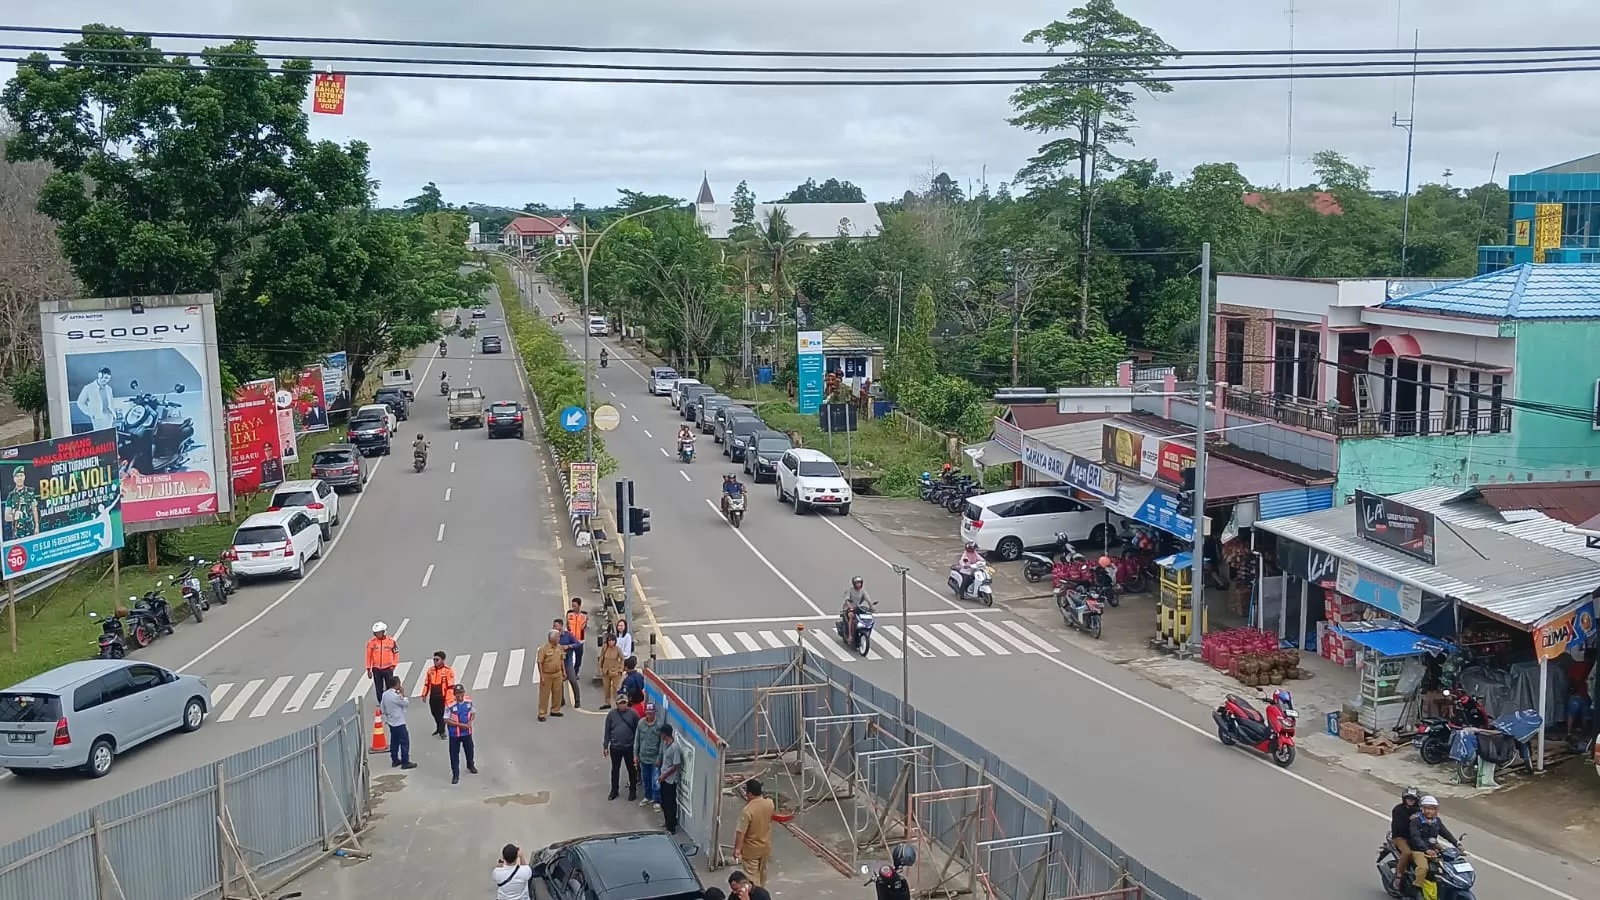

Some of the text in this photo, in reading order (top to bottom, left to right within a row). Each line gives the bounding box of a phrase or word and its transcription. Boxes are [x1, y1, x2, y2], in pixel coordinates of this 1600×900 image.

[316, 92, 343, 100] LISTRIK
[67, 323, 190, 340] SCOOPY
[233, 417, 264, 433] RAYA
[230, 430, 260, 445] TAL
[51, 461, 68, 476] OPEN
[1047, 457, 1065, 476] BARU
[1070, 458, 1087, 484] Agen
[39, 464, 113, 501] BOLA VOLI
[159, 481, 187, 498] JUTA
[46, 487, 108, 508] PUTRA/PUTRI
